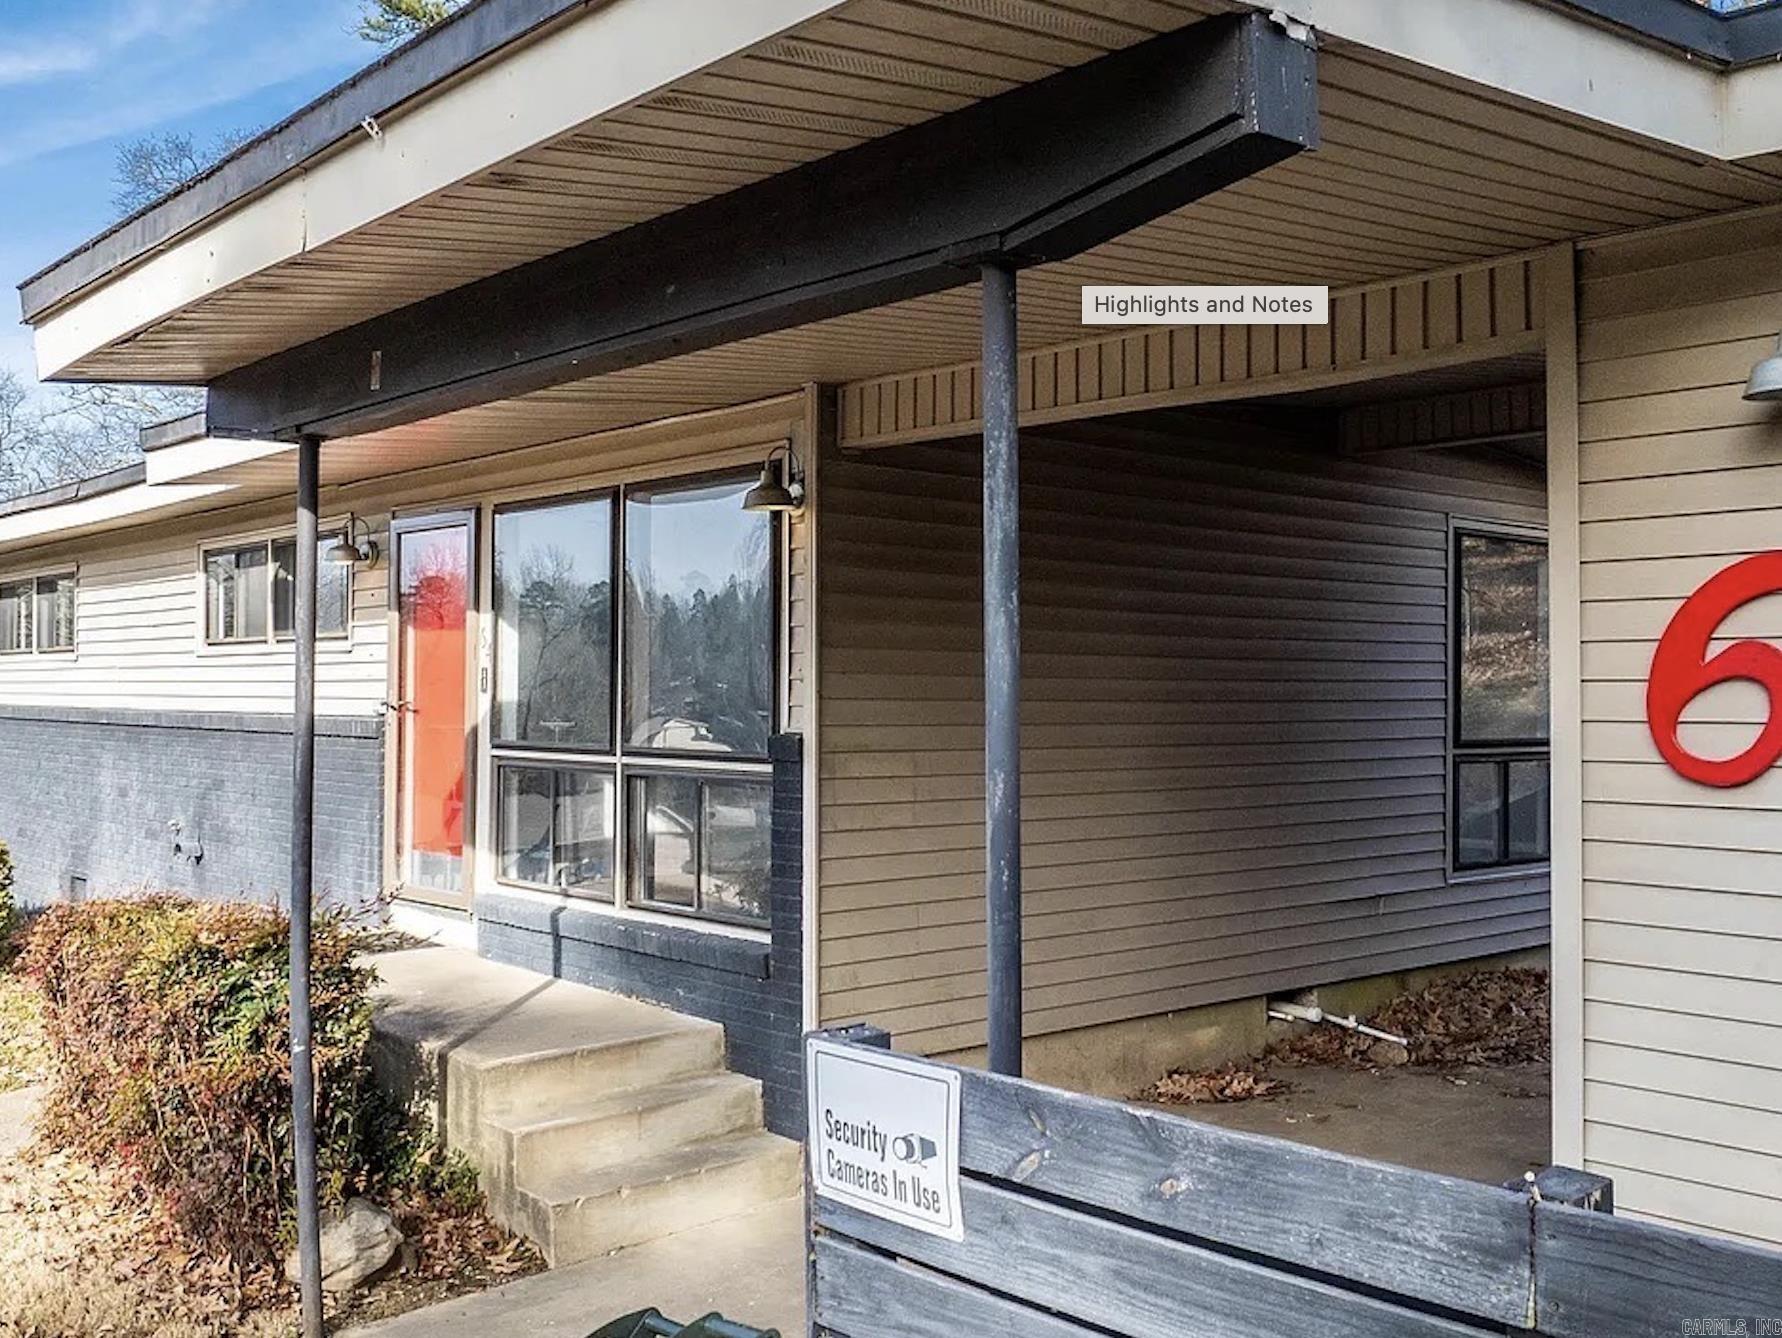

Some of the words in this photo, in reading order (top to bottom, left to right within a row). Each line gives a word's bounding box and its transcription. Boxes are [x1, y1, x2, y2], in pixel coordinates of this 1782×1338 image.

[1646, 550, 1782, 788] 6
[825, 1109, 887, 1162] Security
[827, 1149, 888, 1197] Cameras
[893, 1169, 907, 1204] In
[912, 1177, 941, 1214] Use
